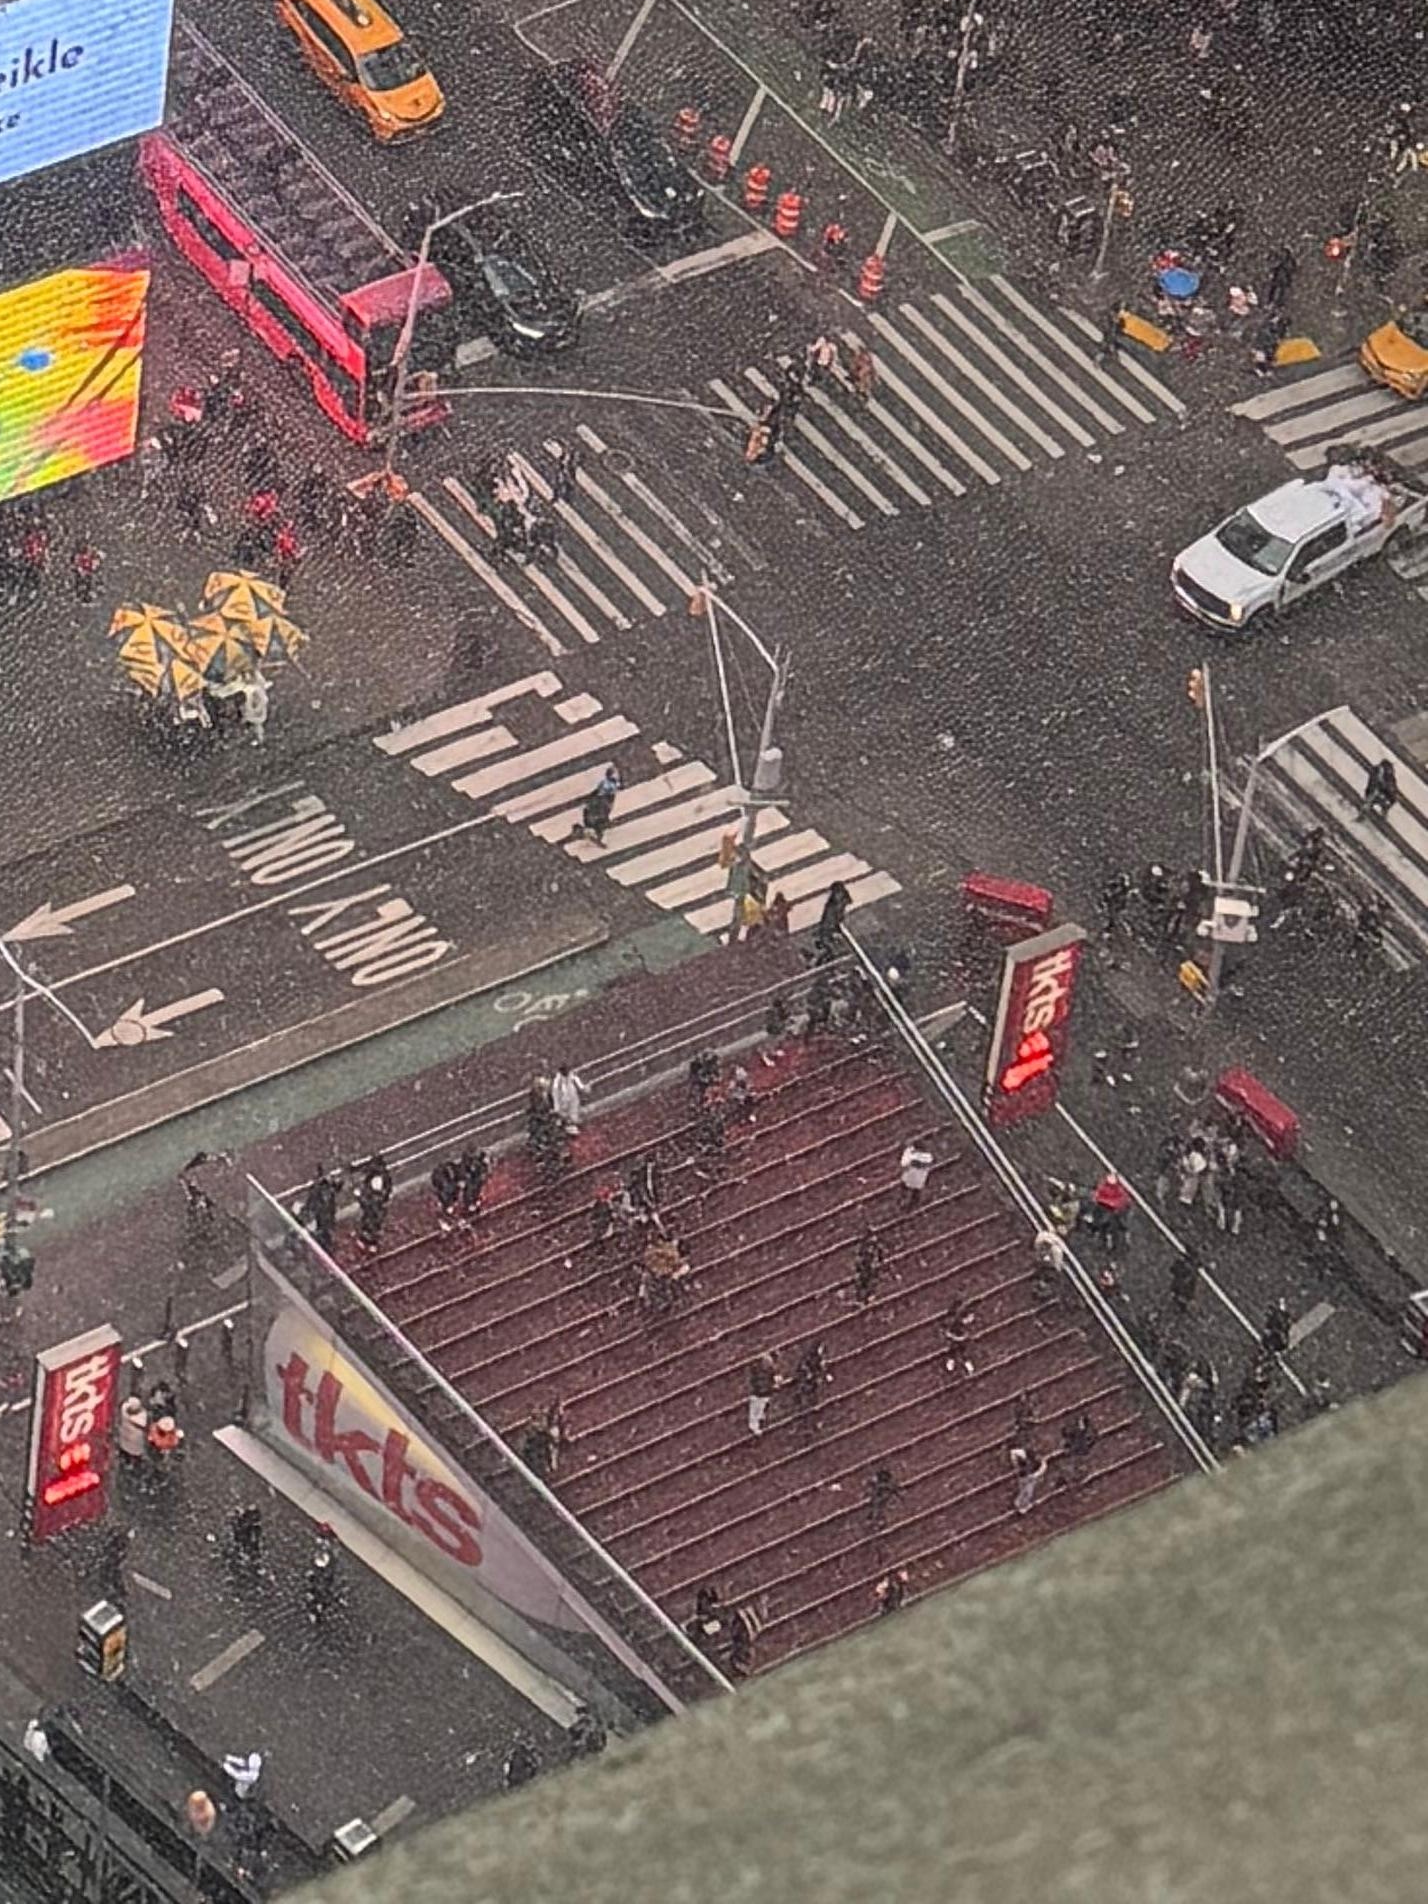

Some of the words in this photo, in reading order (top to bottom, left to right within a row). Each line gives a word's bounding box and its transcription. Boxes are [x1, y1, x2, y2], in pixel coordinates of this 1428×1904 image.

[195, 779, 355, 885] ONLY
[287, 883, 450, 987] ONLY
[1023, 949, 1073, 1034] tkts
[59, 1354, 112, 1444] tkts
[276, 1350, 484, 1569] tkts
